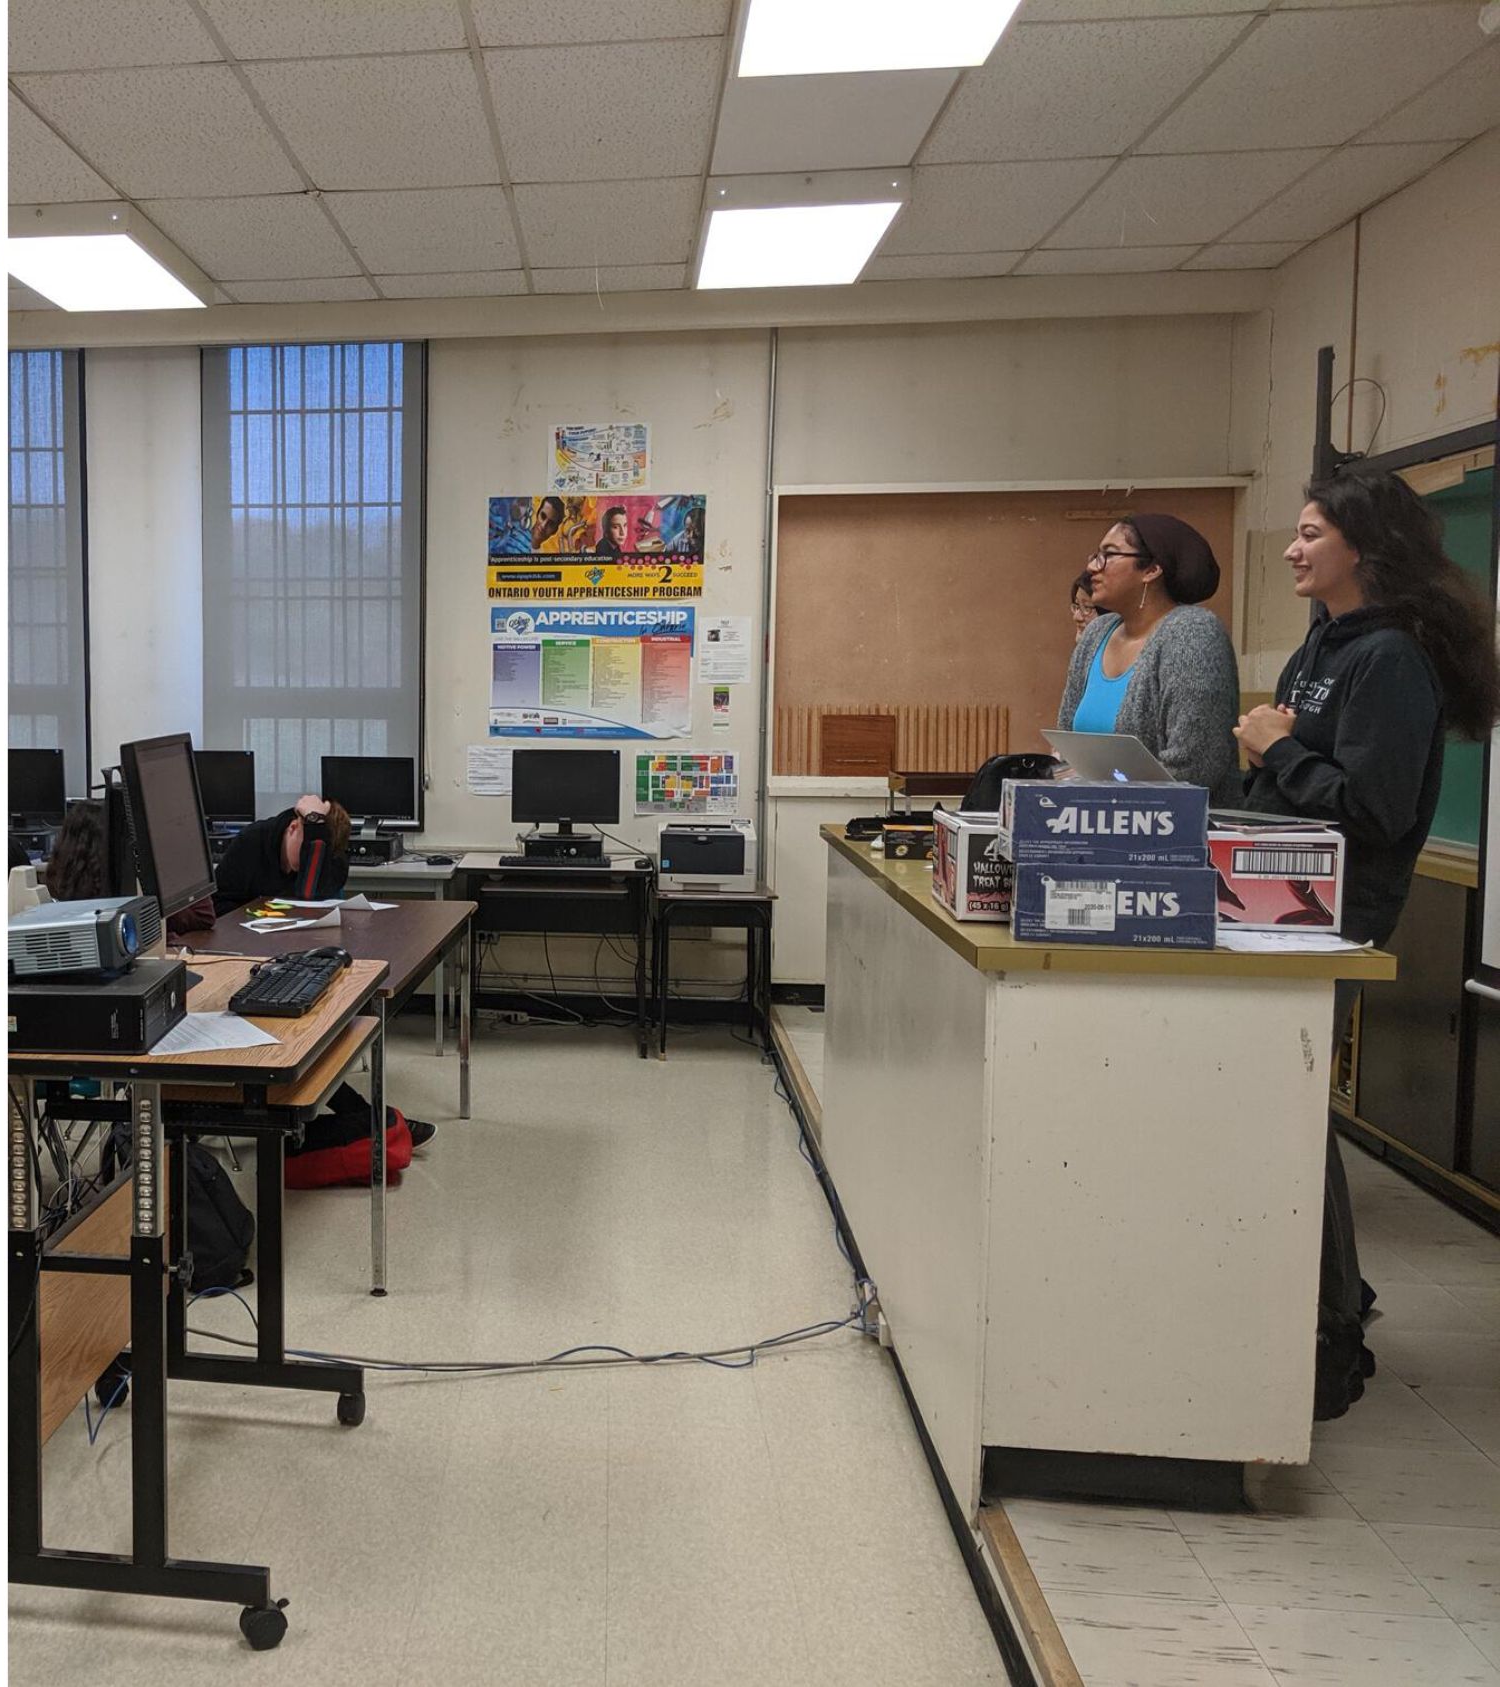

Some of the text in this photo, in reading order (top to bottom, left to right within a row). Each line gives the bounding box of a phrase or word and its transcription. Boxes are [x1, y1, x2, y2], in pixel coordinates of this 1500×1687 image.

[658, 565, 673, 583] 2
[489, 586, 702, 598] ONTARIO YOUTH APPRENTICESHIP PROGRAM
[535, 611, 688, 626] APPRENTICESHIP
[1045, 807, 1175, 836] ALLEN'S
[973, 875, 1001, 888] TREAT
[1117, 891, 1180, 917] EN'S
